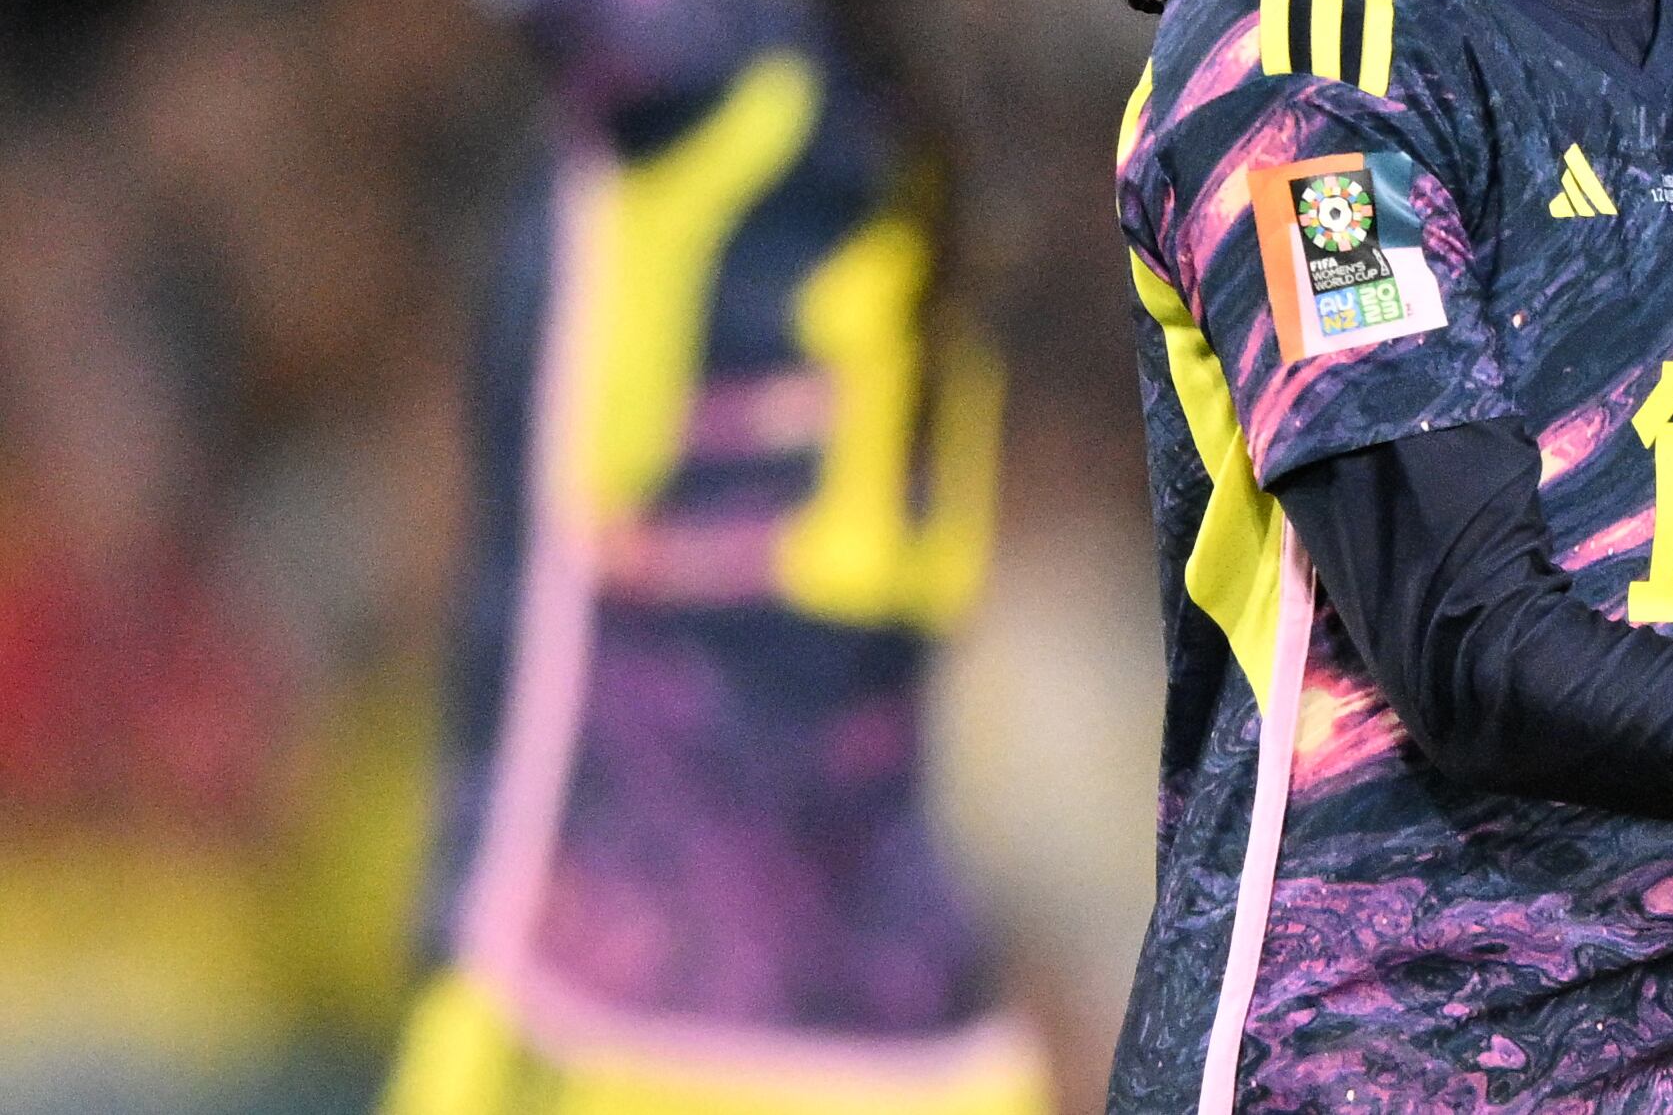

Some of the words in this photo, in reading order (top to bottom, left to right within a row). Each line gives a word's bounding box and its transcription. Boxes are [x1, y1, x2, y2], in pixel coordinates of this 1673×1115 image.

[1651, 188, 1664, 202] 12
[1309, 257, 1338, 272] FIFA
[1314, 274, 1354, 291] WORLD
[1355, 268, 1378, 282] CUP
[1320, 291, 1354, 316] AU
[1323, 309, 1358, 333] NZ
